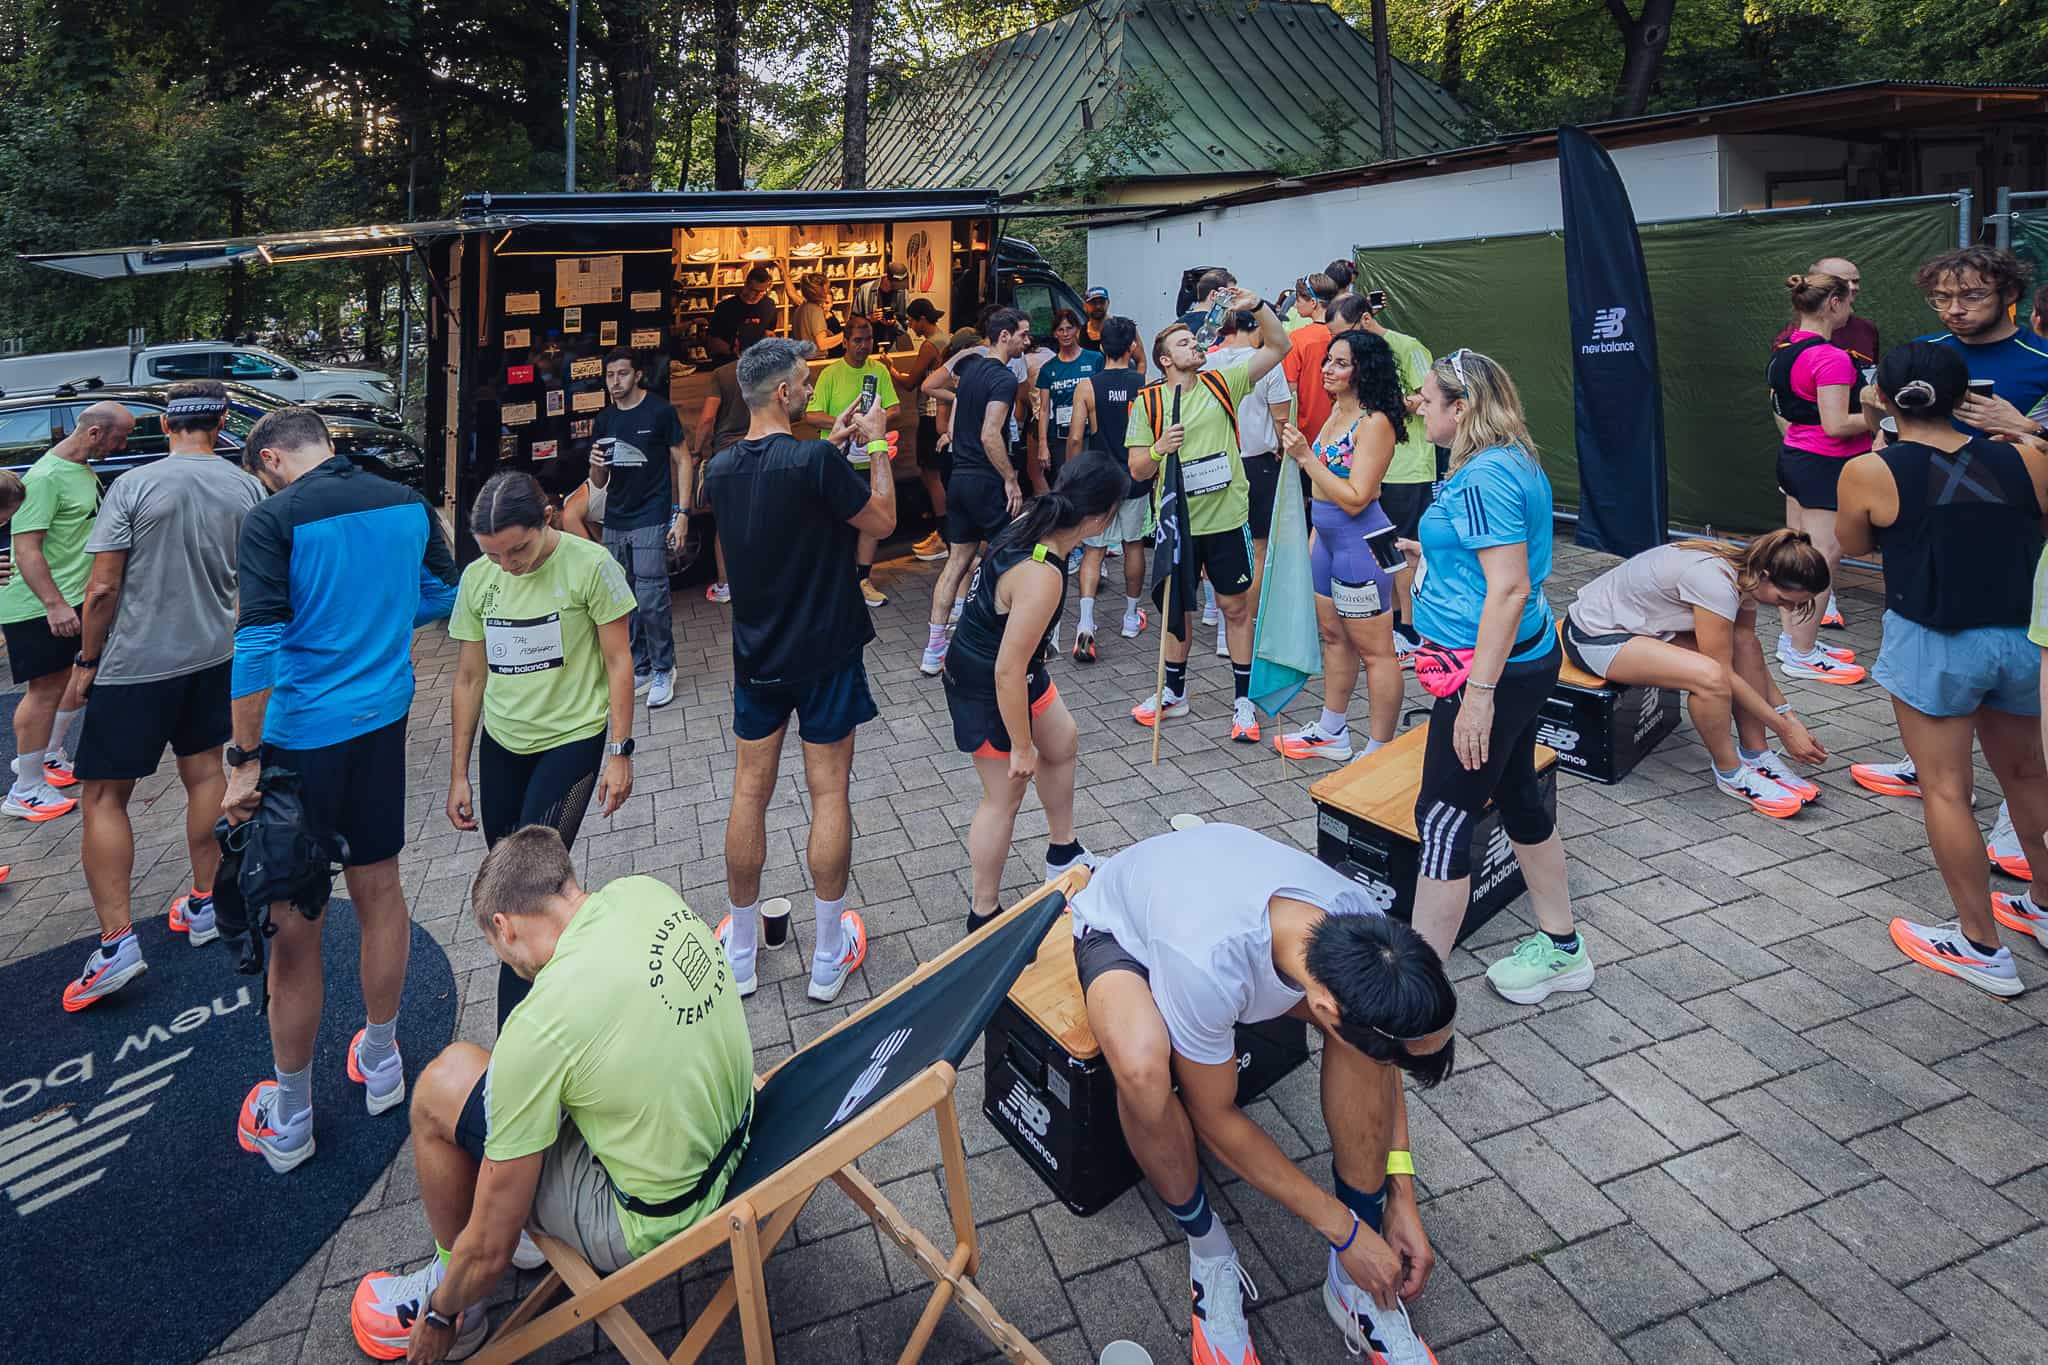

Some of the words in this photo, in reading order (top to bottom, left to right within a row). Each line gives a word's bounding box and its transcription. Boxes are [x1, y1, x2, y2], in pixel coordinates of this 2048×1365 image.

[1582, 344, 1600, 354] new
[1601, 341, 1635, 353] balance
[514, 662, 550, 673] balance
[1556, 750, 1588, 767] lance
[1472, 878, 1491, 903] new
[1491, 858, 1521, 888] balanc
[113, 985, 250, 1063] new
[676, 994, 714, 1025] TEAM
[998, 1100, 1018, 1127] new
[1016, 1121, 1059, 1171] balance
